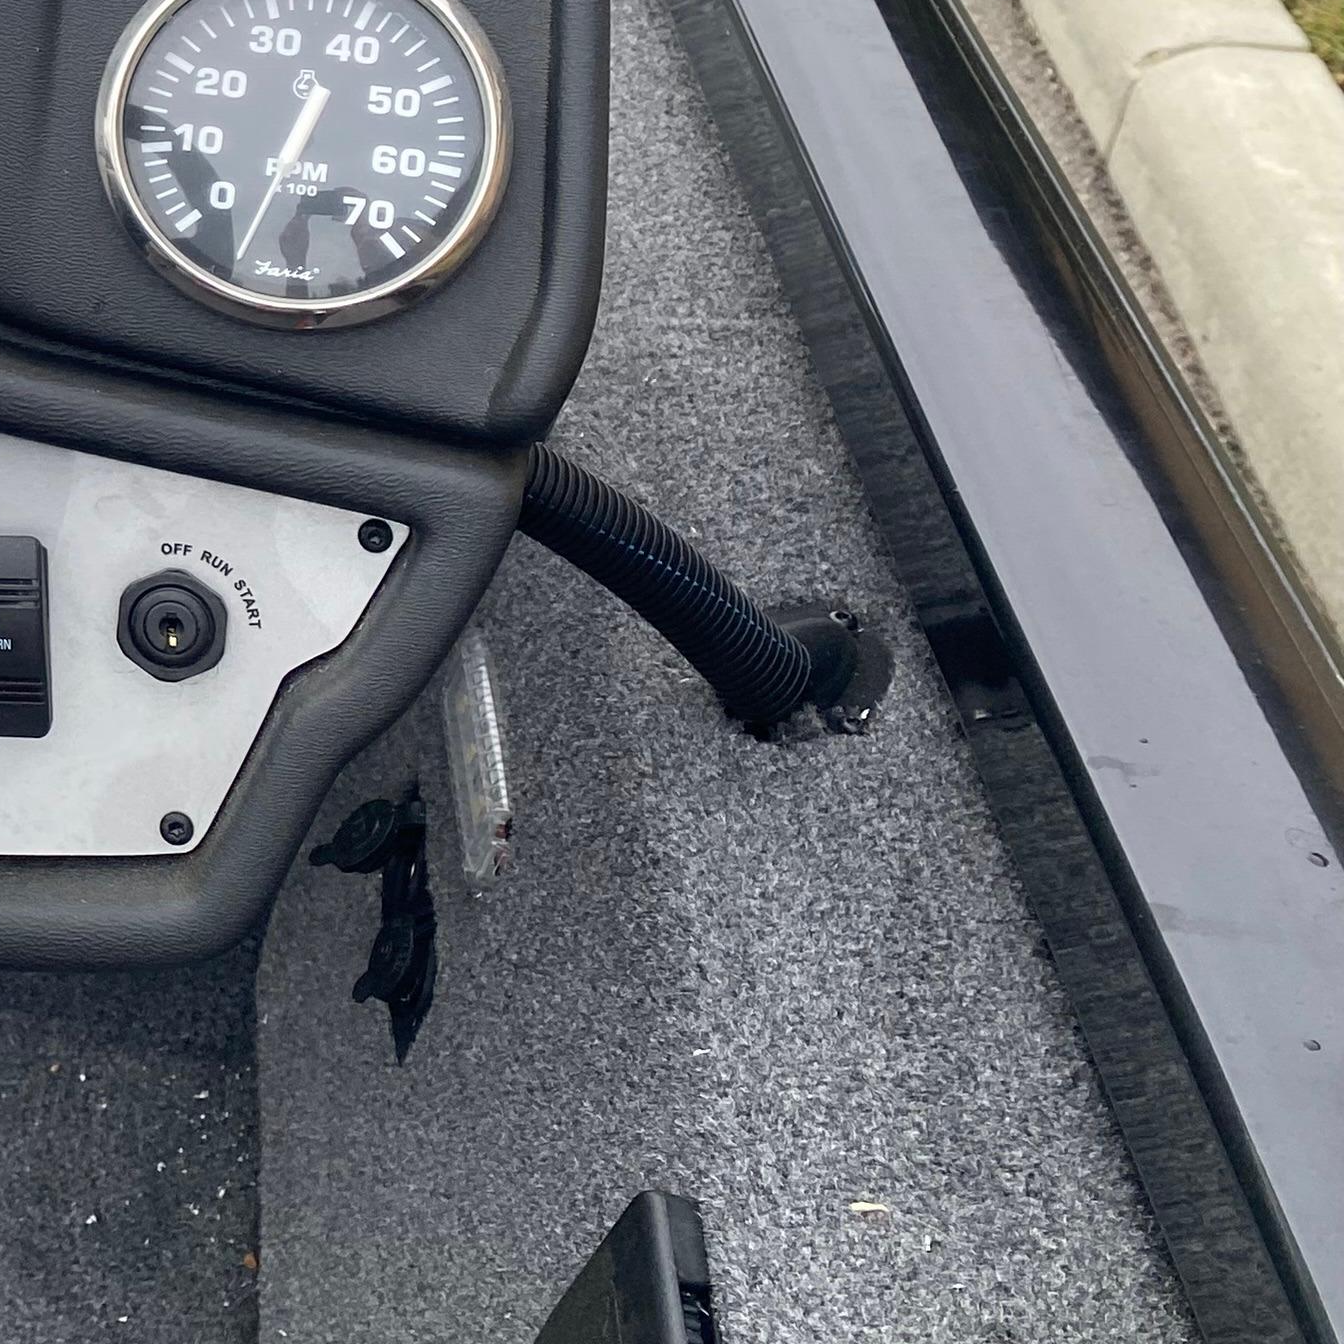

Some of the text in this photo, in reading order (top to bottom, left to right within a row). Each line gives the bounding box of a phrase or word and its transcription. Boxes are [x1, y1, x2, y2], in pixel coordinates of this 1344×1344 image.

[249, 25, 302, 56] 30
[325, 33, 380, 65] 40
[195, 67, 247, 98] 20
[367, 85, 421, 117] 50
[173, 123, 223, 154] 10
[265, 157, 328, 183] RPM
[372, 145, 426, 177] 60
[210, 181, 236, 209] 0
[286, 182, 318, 197] 100
[342, 196, 394, 229] 70
[160, 542, 262, 630] OFF RUN START
